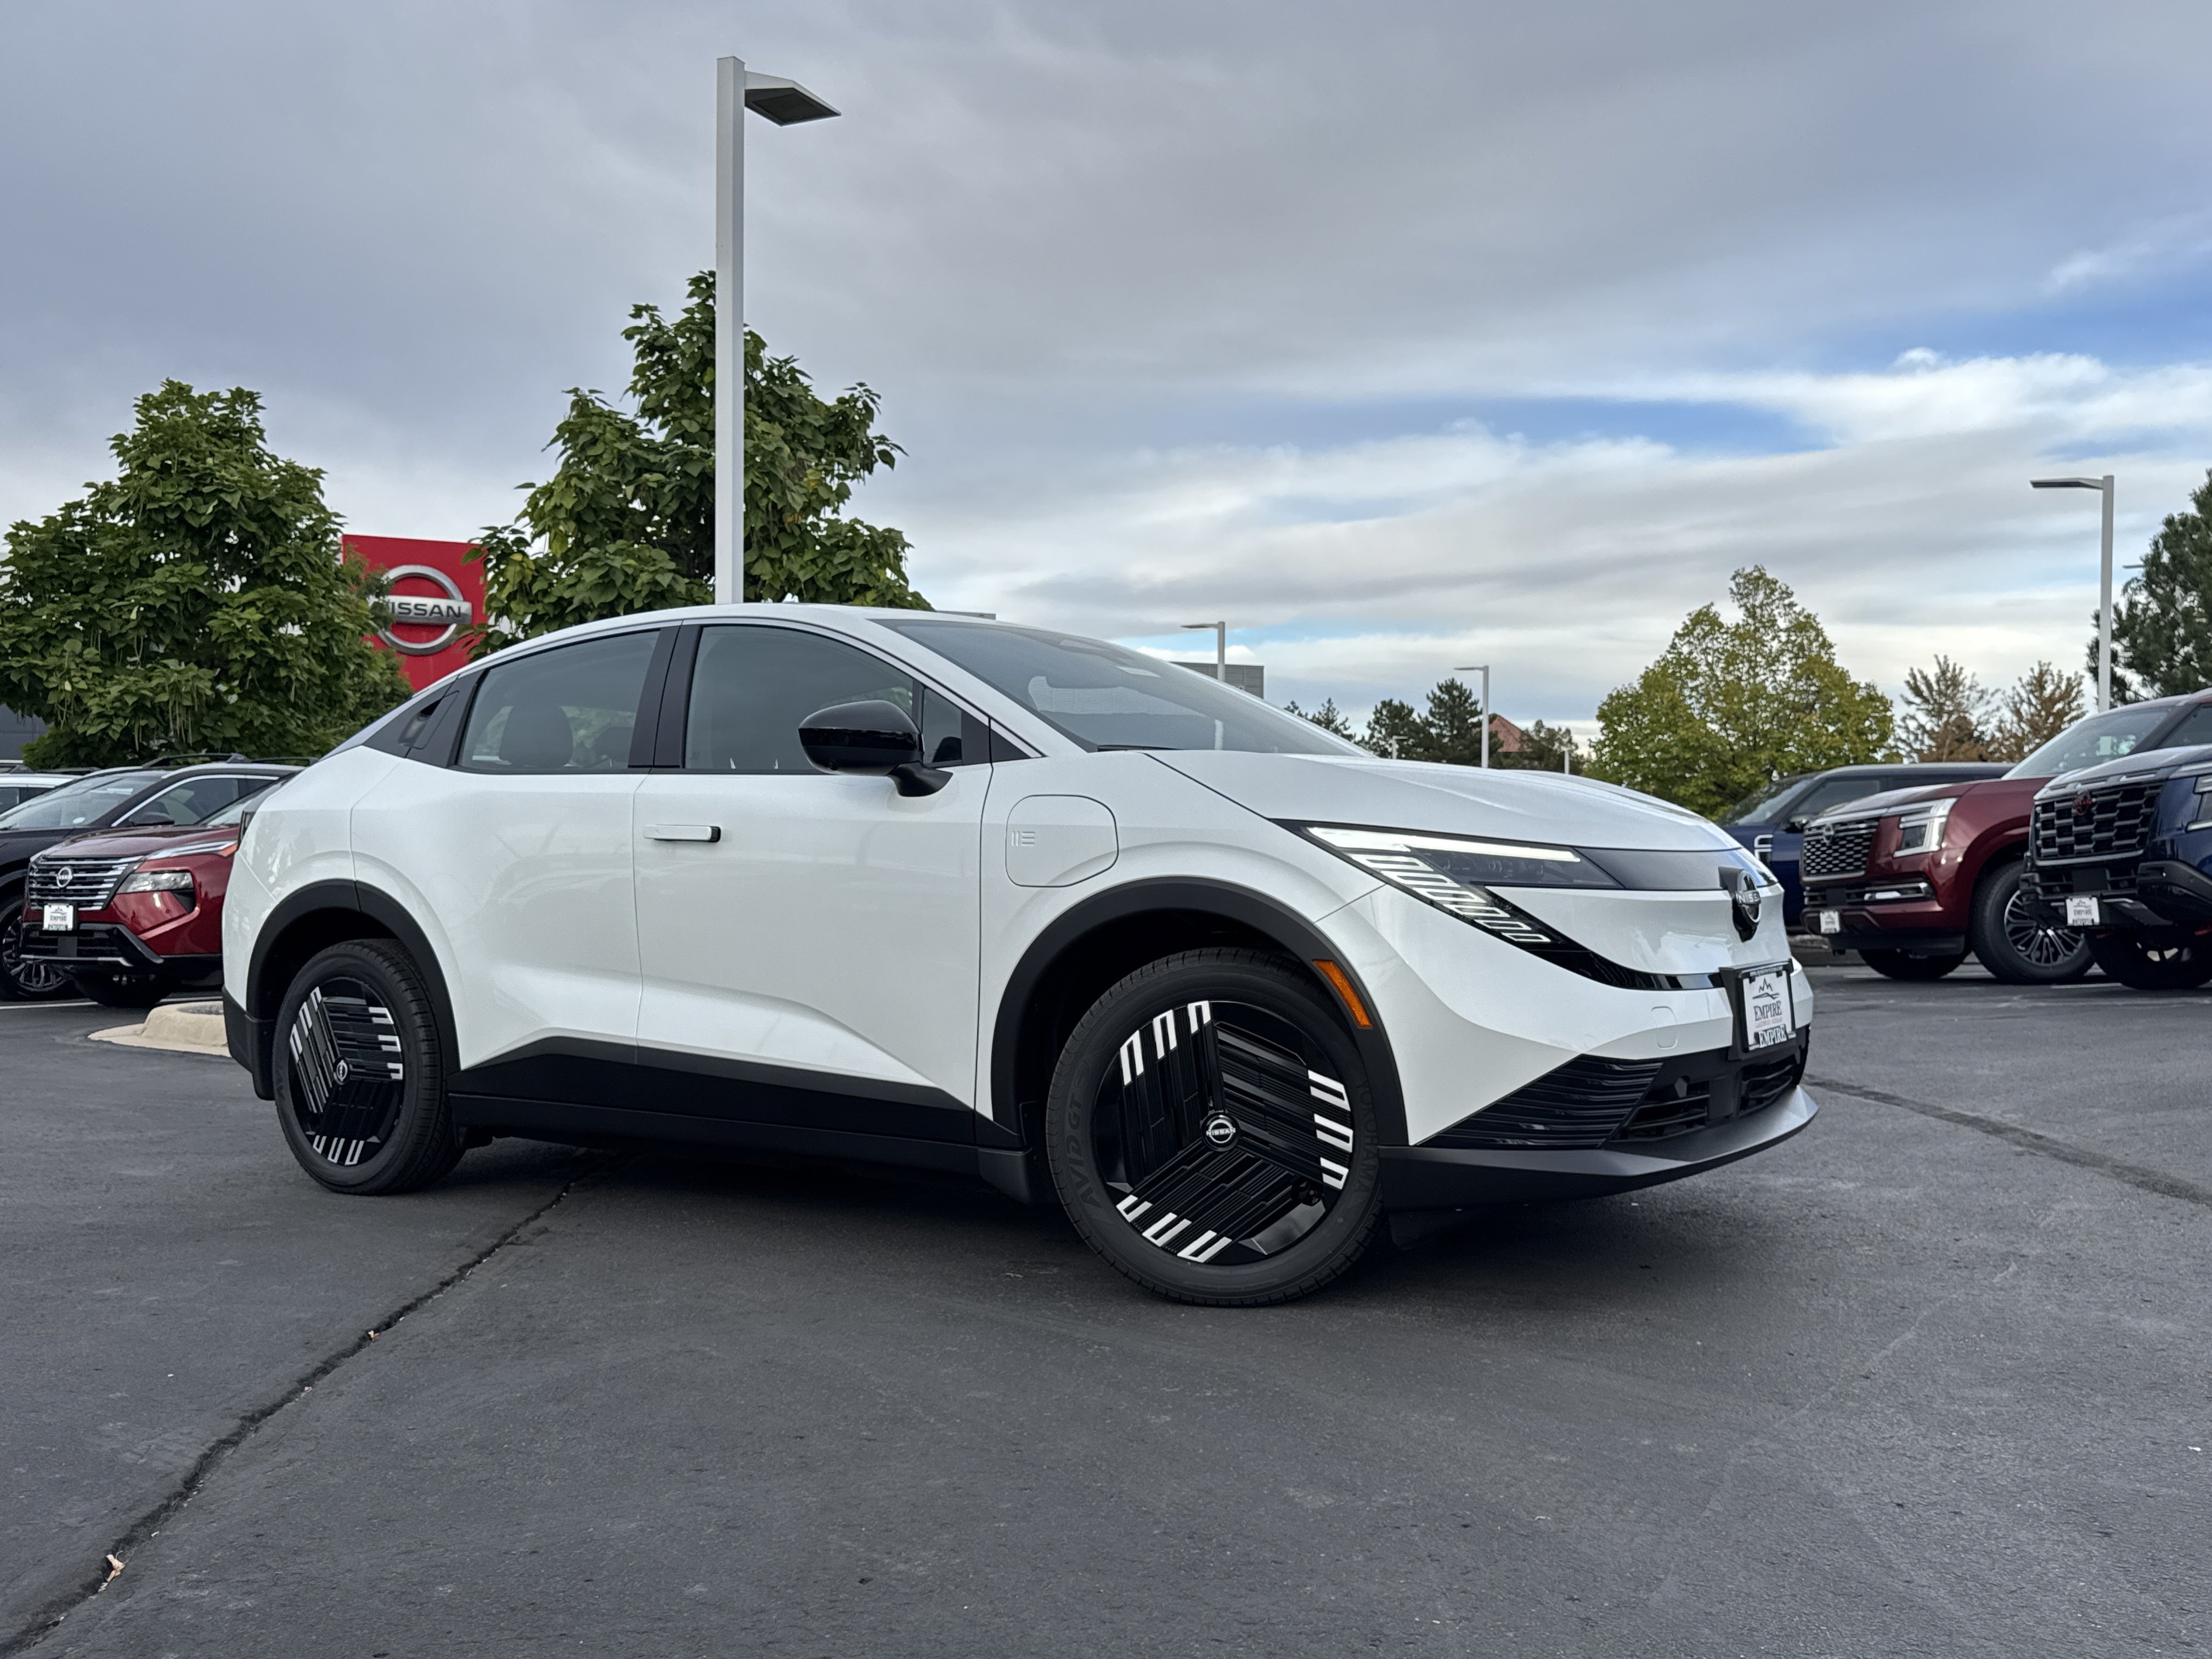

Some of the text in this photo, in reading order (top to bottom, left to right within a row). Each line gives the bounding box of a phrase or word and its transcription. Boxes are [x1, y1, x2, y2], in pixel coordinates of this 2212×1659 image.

[391, 601, 461, 618] ISSAN
[1753, 1001, 1782, 1022] EMPIRE
[1758, 1024, 1787, 1048] EMPIRE
[1206, 1127, 1236, 1137] NISSAN
[1354, 1080, 1379, 1193] YOKOHAMA
